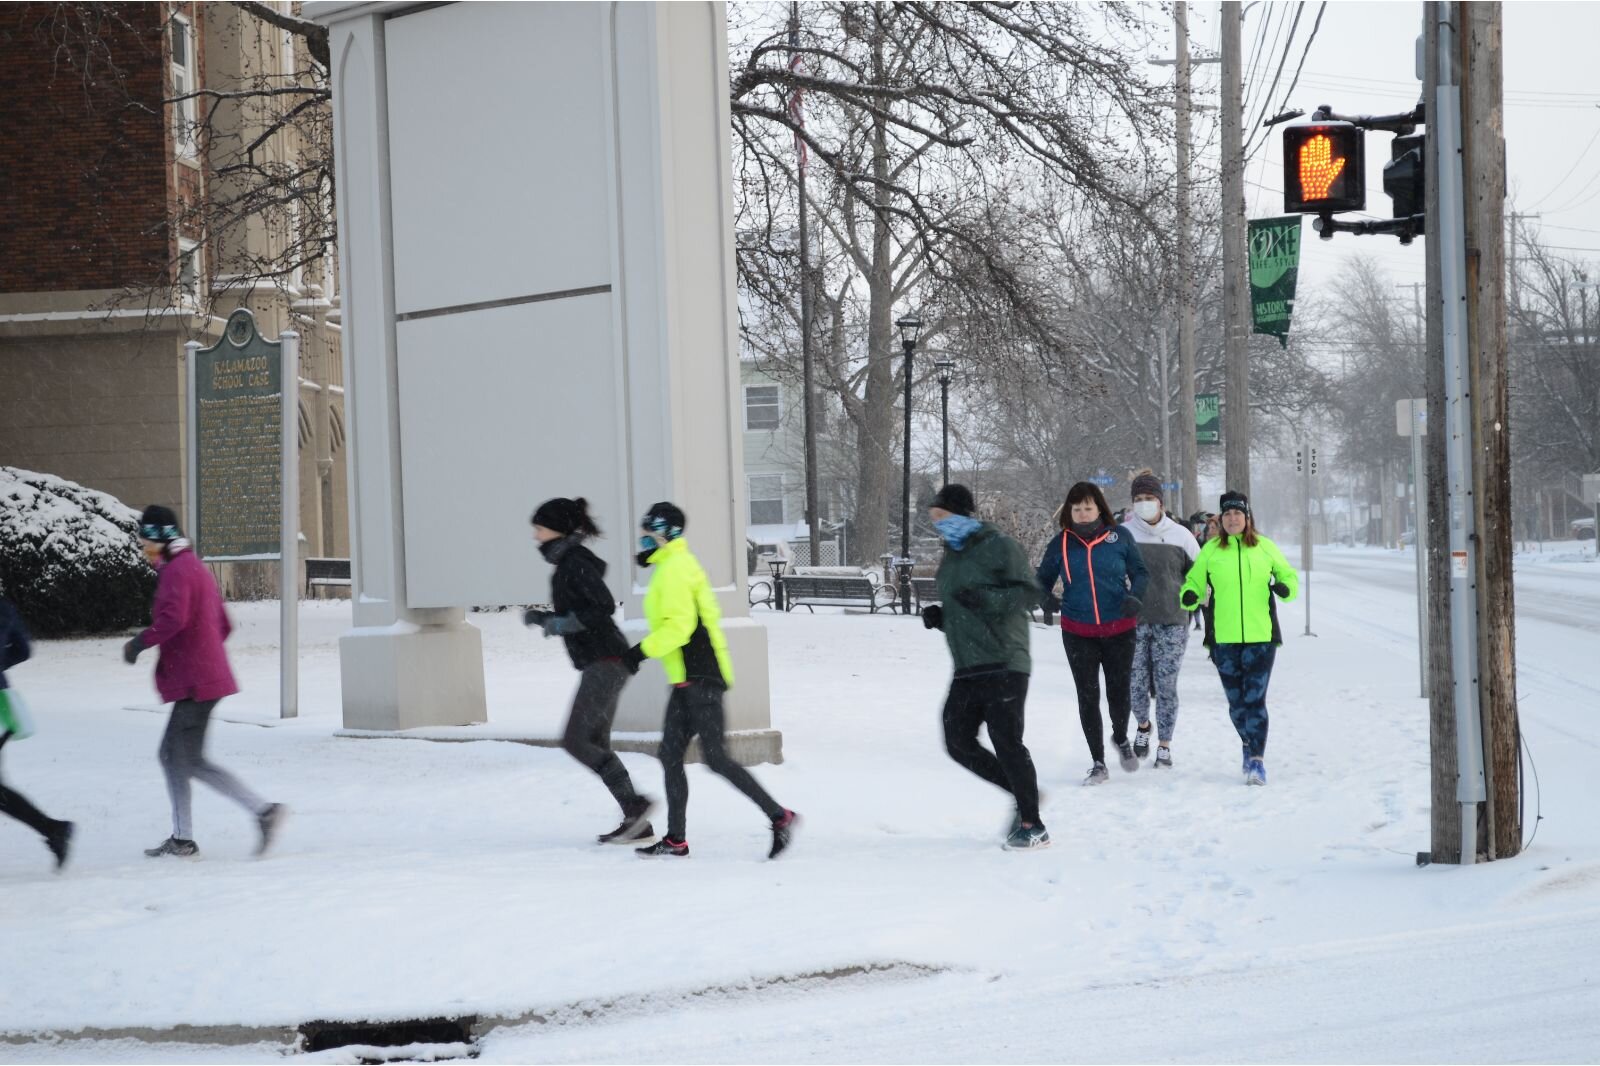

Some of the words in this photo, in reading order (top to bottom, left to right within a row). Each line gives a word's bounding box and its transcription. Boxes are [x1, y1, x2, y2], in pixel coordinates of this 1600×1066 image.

[214, 356, 268, 374] KALAMAZOO
[213, 375, 244, 390] SCHOOL
[249, 371, 269, 387] CASE
